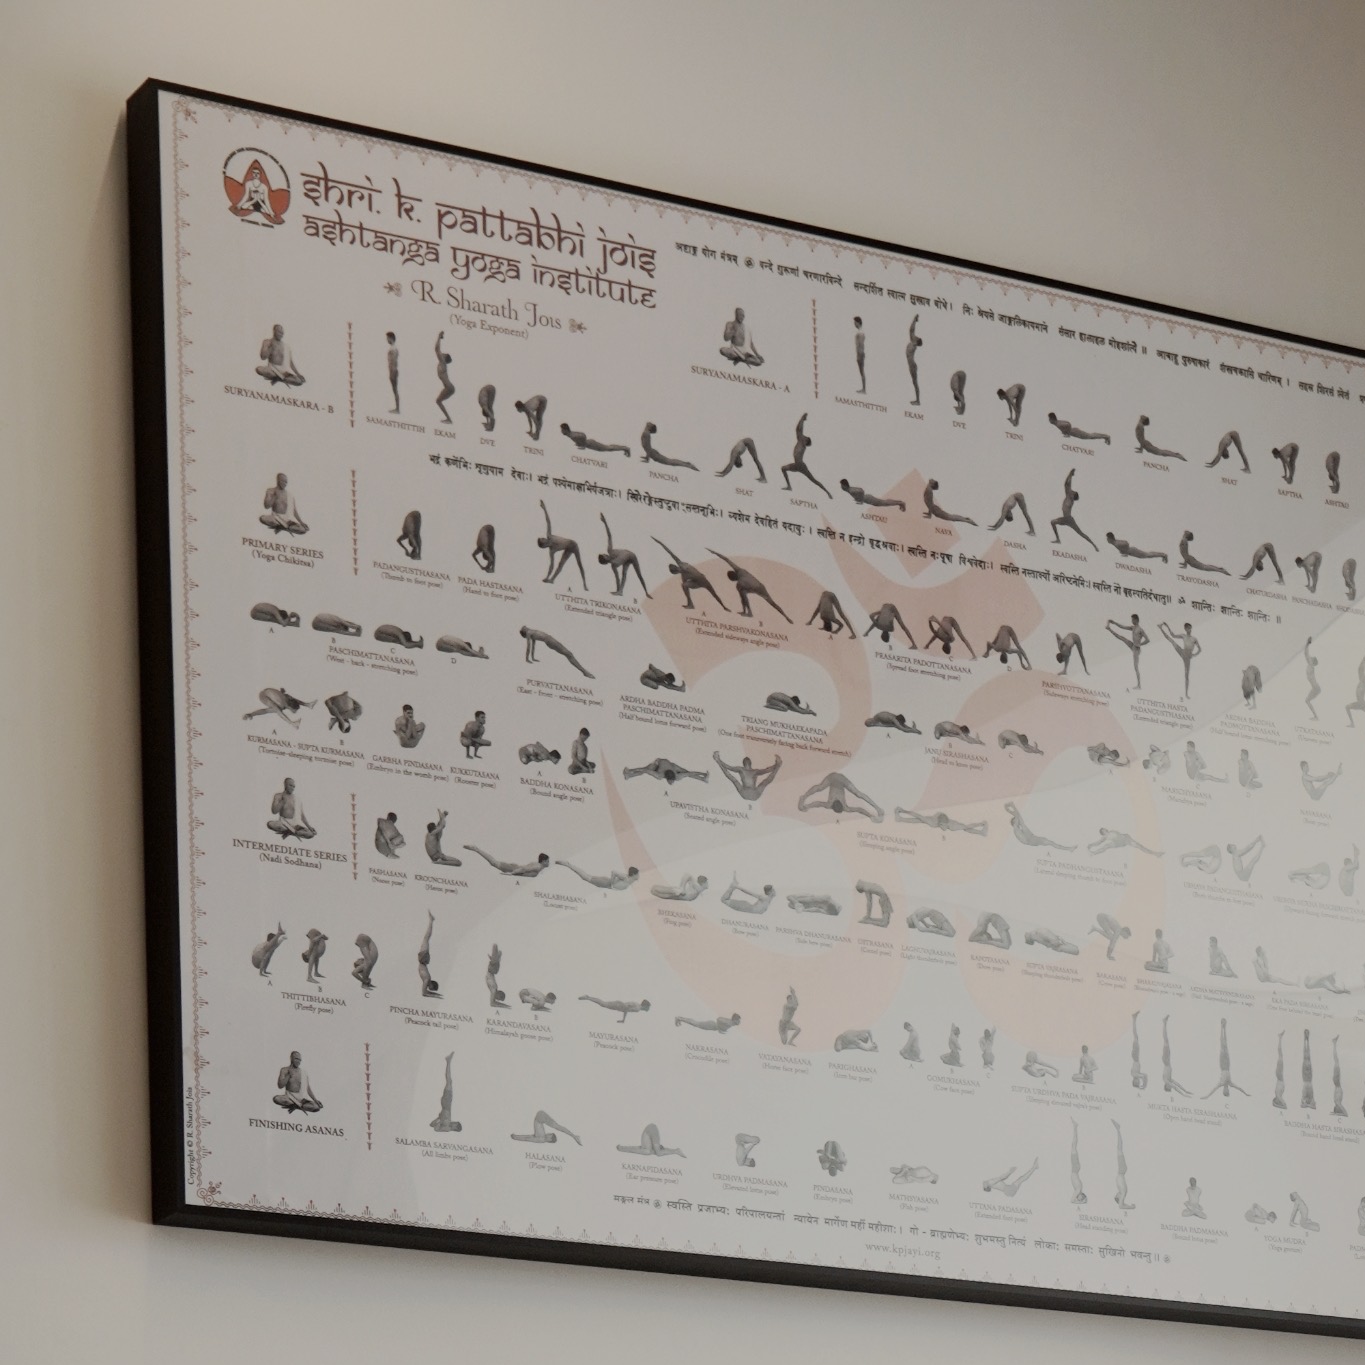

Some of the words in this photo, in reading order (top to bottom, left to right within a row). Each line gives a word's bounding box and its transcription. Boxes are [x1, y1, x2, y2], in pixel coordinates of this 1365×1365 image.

[300, 161, 382, 214] shri.
[392, 177, 423, 224] k.
[435, 202, 586, 258] pattabhi
[596, 226, 658, 278] jois
[302, 209, 440, 266] ashtanga
[450, 246, 521, 283] yoga
[531, 254, 657, 308] institute
[447, 286, 519, 321] Sharath
[525, 302, 562, 330] Jois
[449, 314, 477, 331] (Yoga
[480, 320, 529, 340] Exponent)
[690, 364, 777, 391] SURYANAMASKARA
[223, 384, 320, 412] SURYANAMASKARA
[241, 536, 288, 553] PRIMARY
[289, 545, 324, 560] SERIES
[251, 548, 276, 563] (Yoga
[232, 837, 312, 858] INTERMEDIATE
[313, 849, 348, 863] SERIES
[258, 851, 283, 864] (Nadi
[248, 1117, 303, 1133] FINISHING
[303, 1124, 344, 1137] ASANAS
[187, 1148, 196, 1185] Copyright
[864, 1242, 941, 1261] www.kpjayi.org
